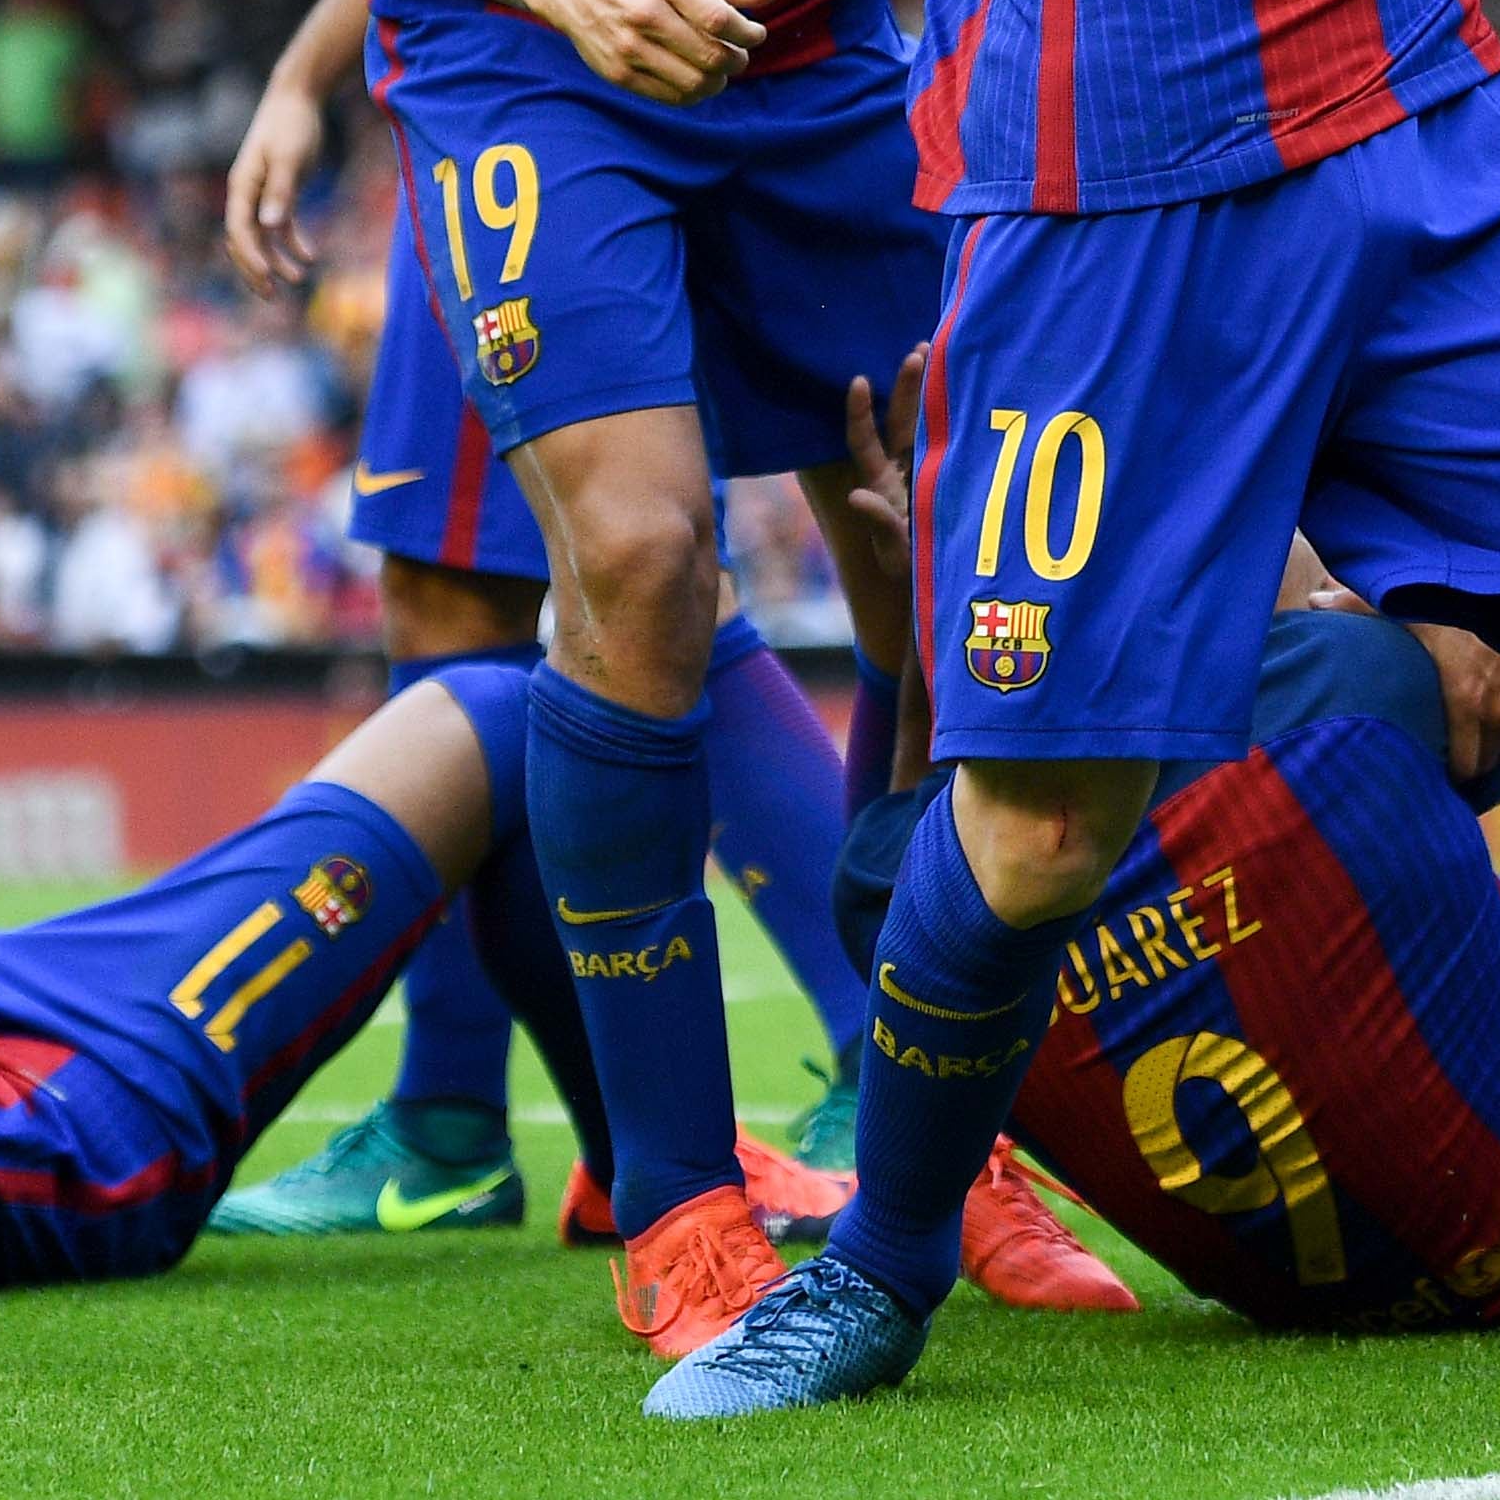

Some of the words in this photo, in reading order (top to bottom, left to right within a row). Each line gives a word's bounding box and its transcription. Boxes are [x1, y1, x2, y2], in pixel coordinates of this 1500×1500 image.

[433, 144, 539, 301] 19
[975, 409, 1107, 582] 10
[169, 902, 312, 1052] 11
[568, 935, 692, 982] BARÇA
[1122, 1030, 1347, 1285] 9
